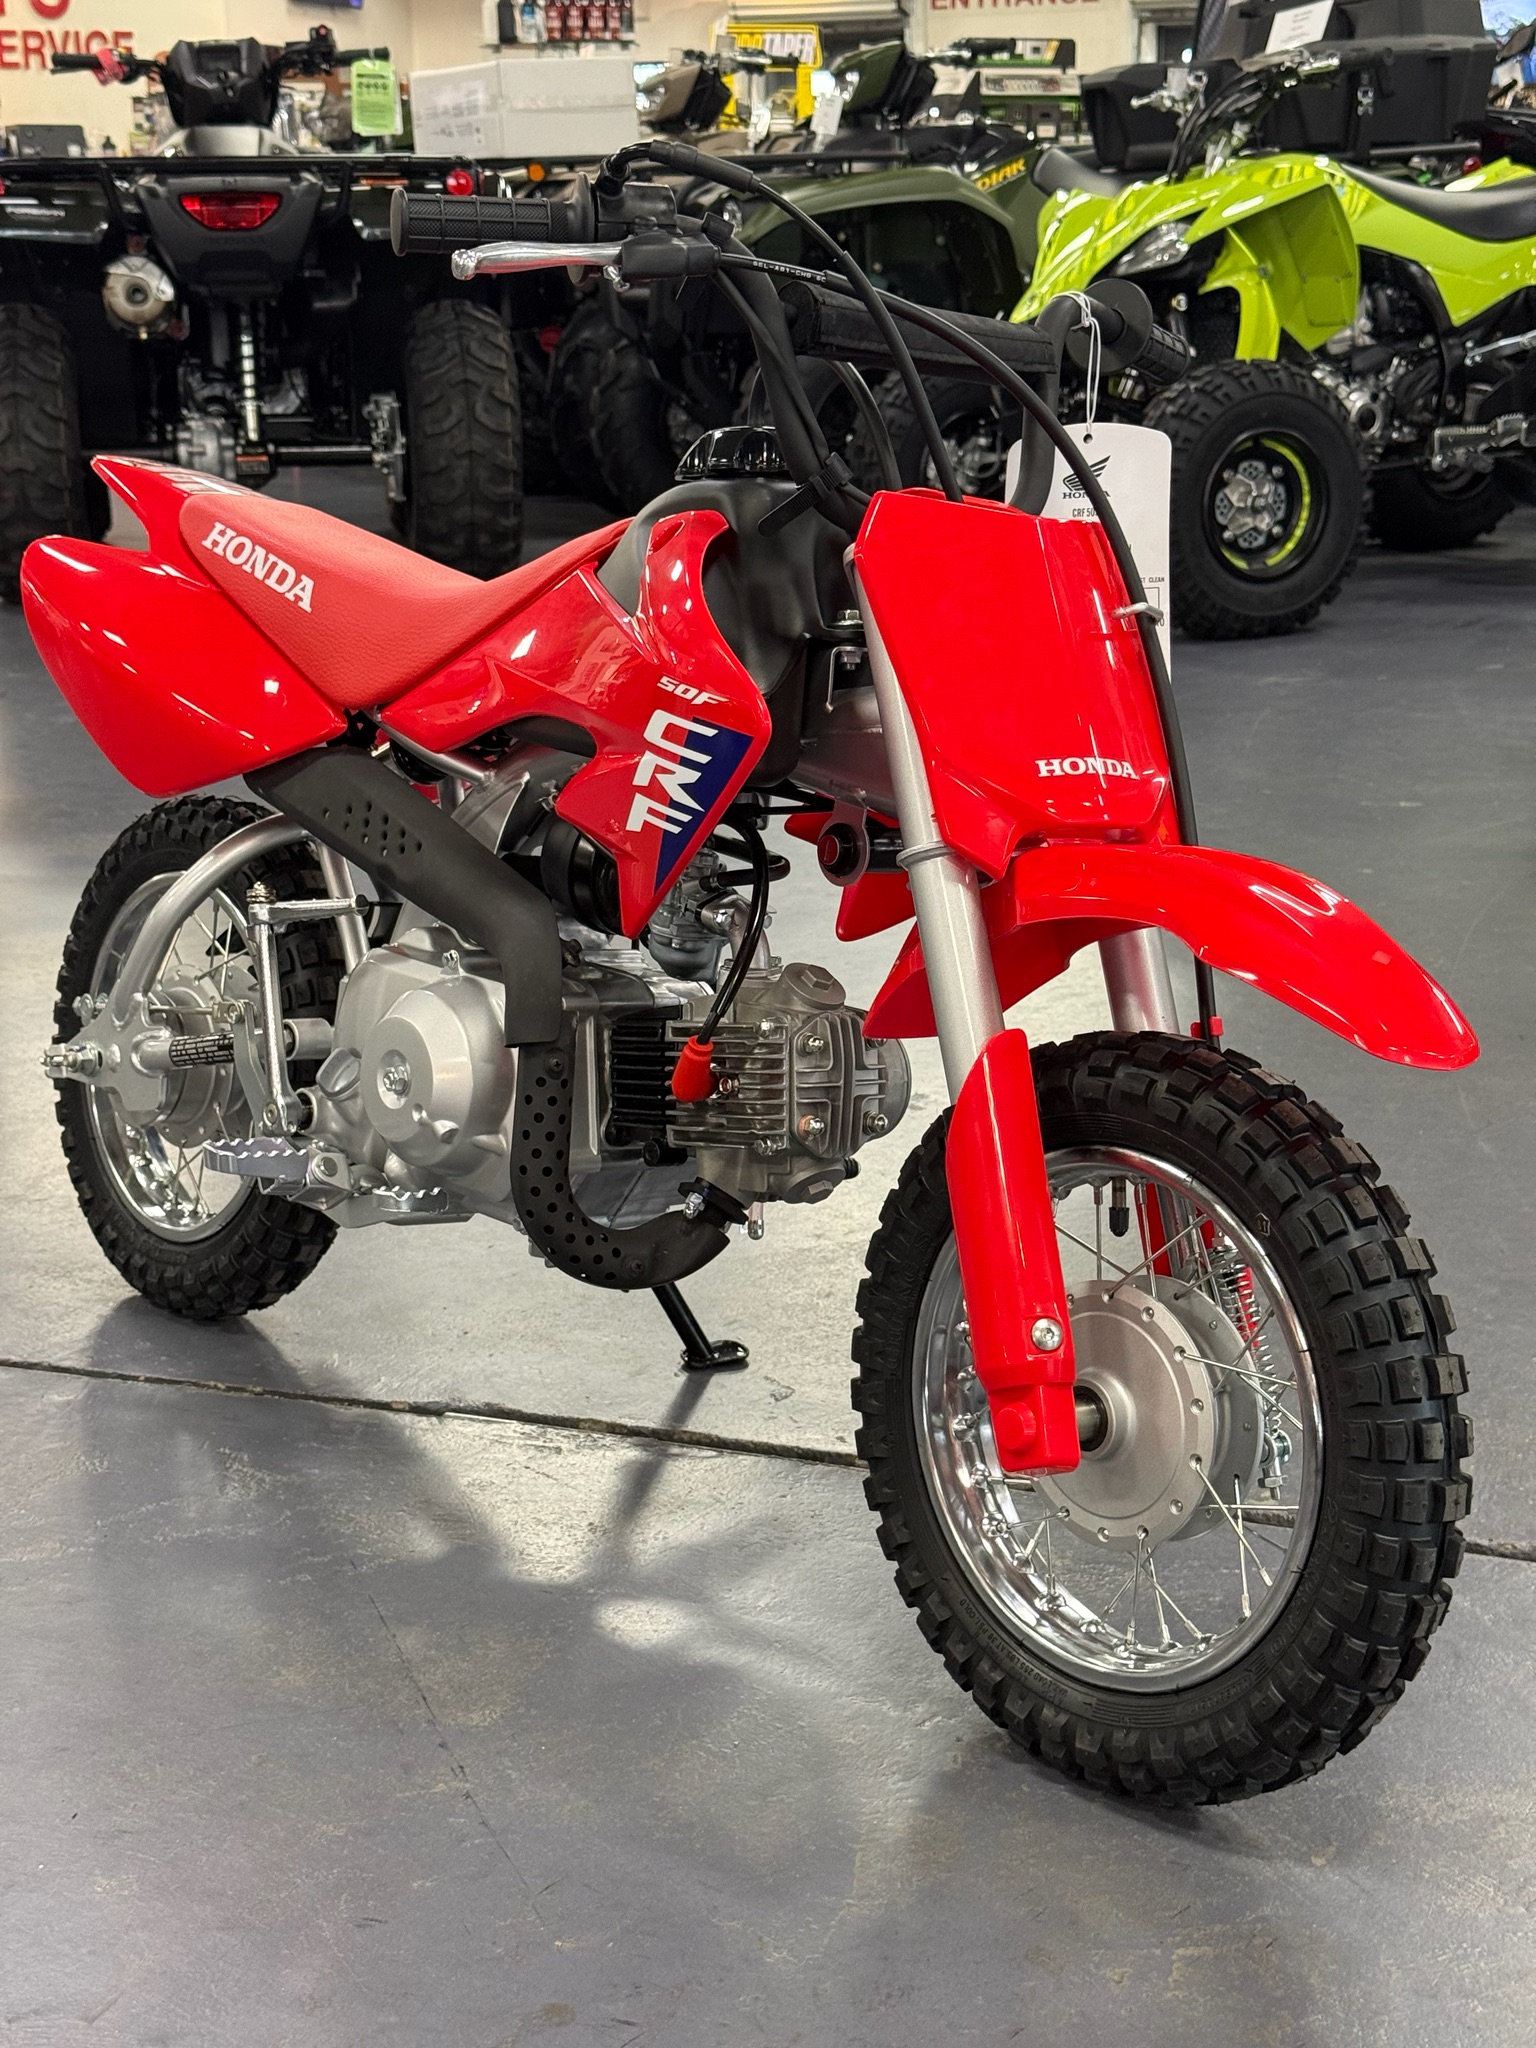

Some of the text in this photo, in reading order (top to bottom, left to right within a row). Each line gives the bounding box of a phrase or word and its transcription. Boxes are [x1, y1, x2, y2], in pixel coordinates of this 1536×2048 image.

[0, 29, 134, 70] ERVICE
[1062, 490, 1111, 499] HOA
[1072, 508, 1085, 518] CRF
[201, 521, 315, 613] HONDA
[656, 675, 730, 705] 50F
[625, 708, 719, 835] CRF
[1034, 757, 1141, 781] HONDA
